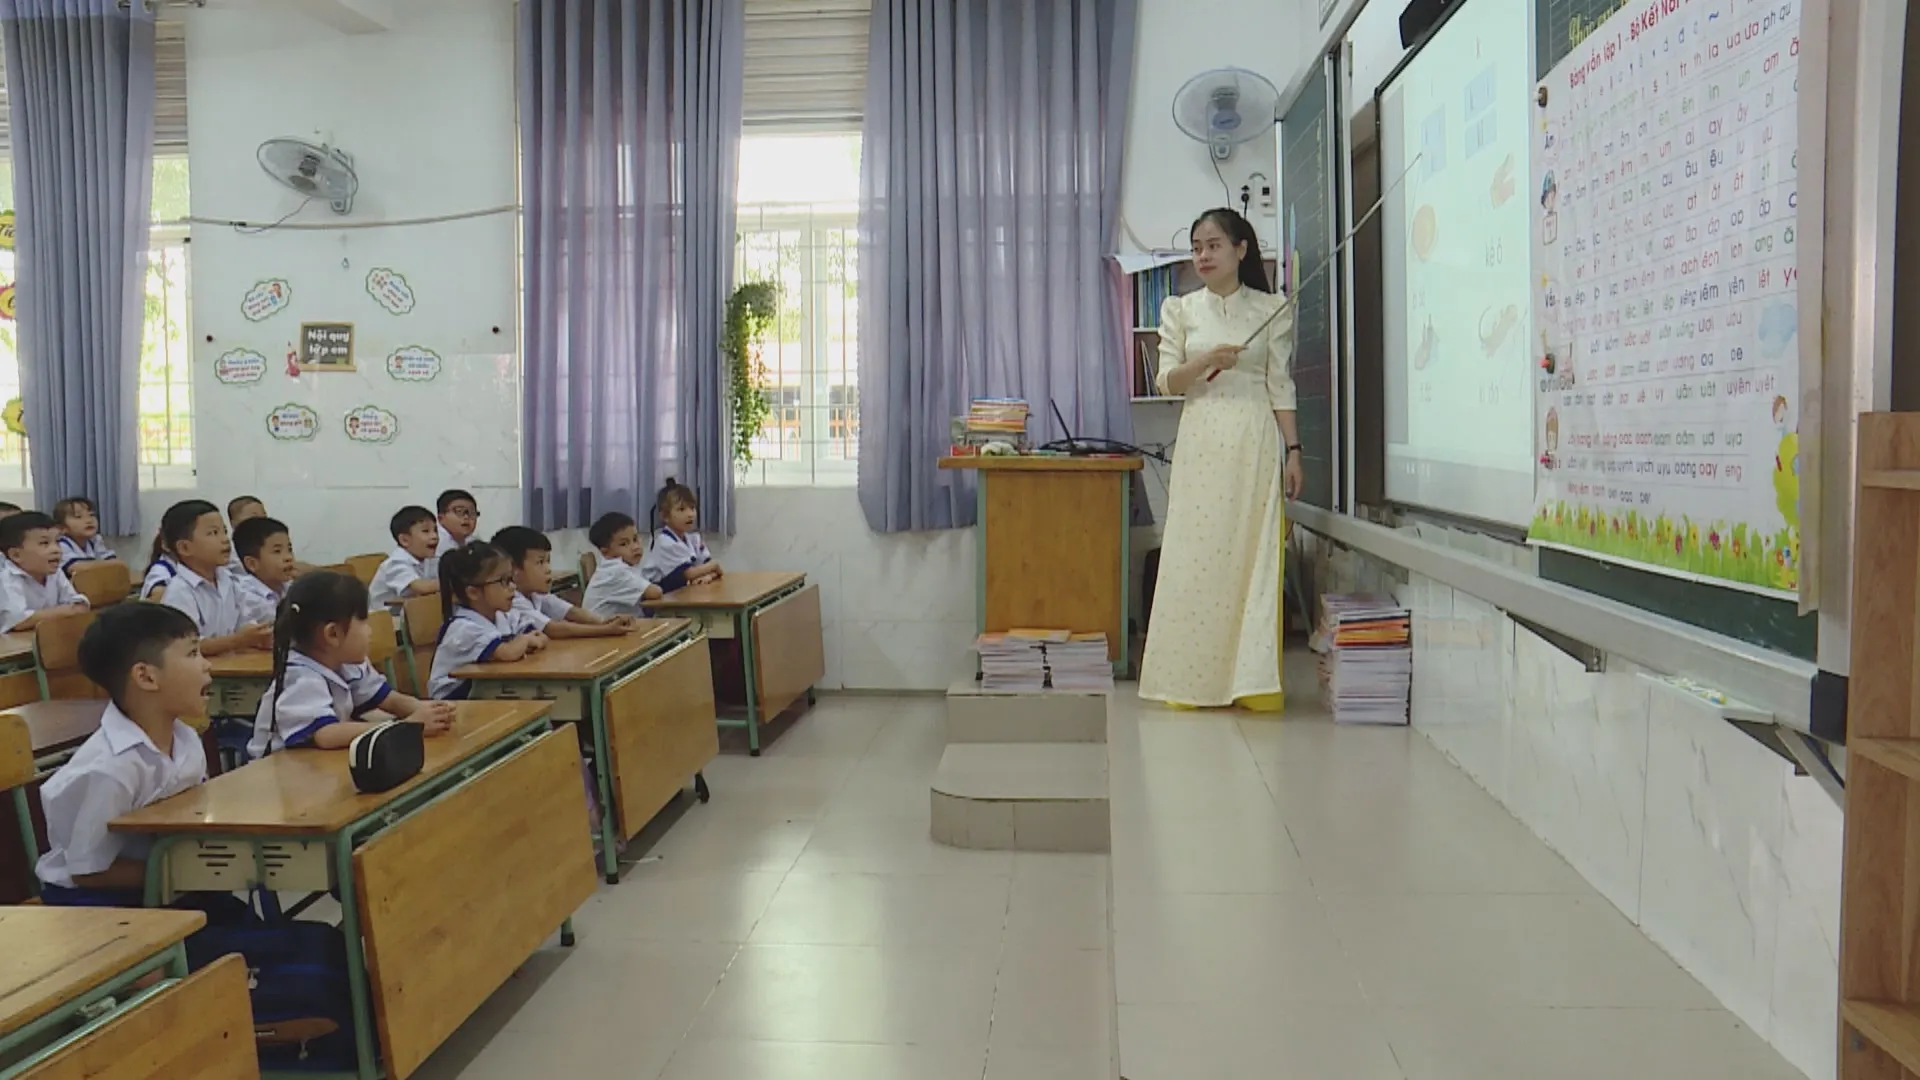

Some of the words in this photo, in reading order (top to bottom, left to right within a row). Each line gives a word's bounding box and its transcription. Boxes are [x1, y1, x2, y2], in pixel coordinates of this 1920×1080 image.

[1641, 0, 1659, 32] Kết
[1709, 117, 1723, 137] ay
[308, 329, 327, 342] Nội
[329, 332, 350, 342] quy
[309, 343, 329, 356] lớp
[1701, 353, 1714, 366] oa
